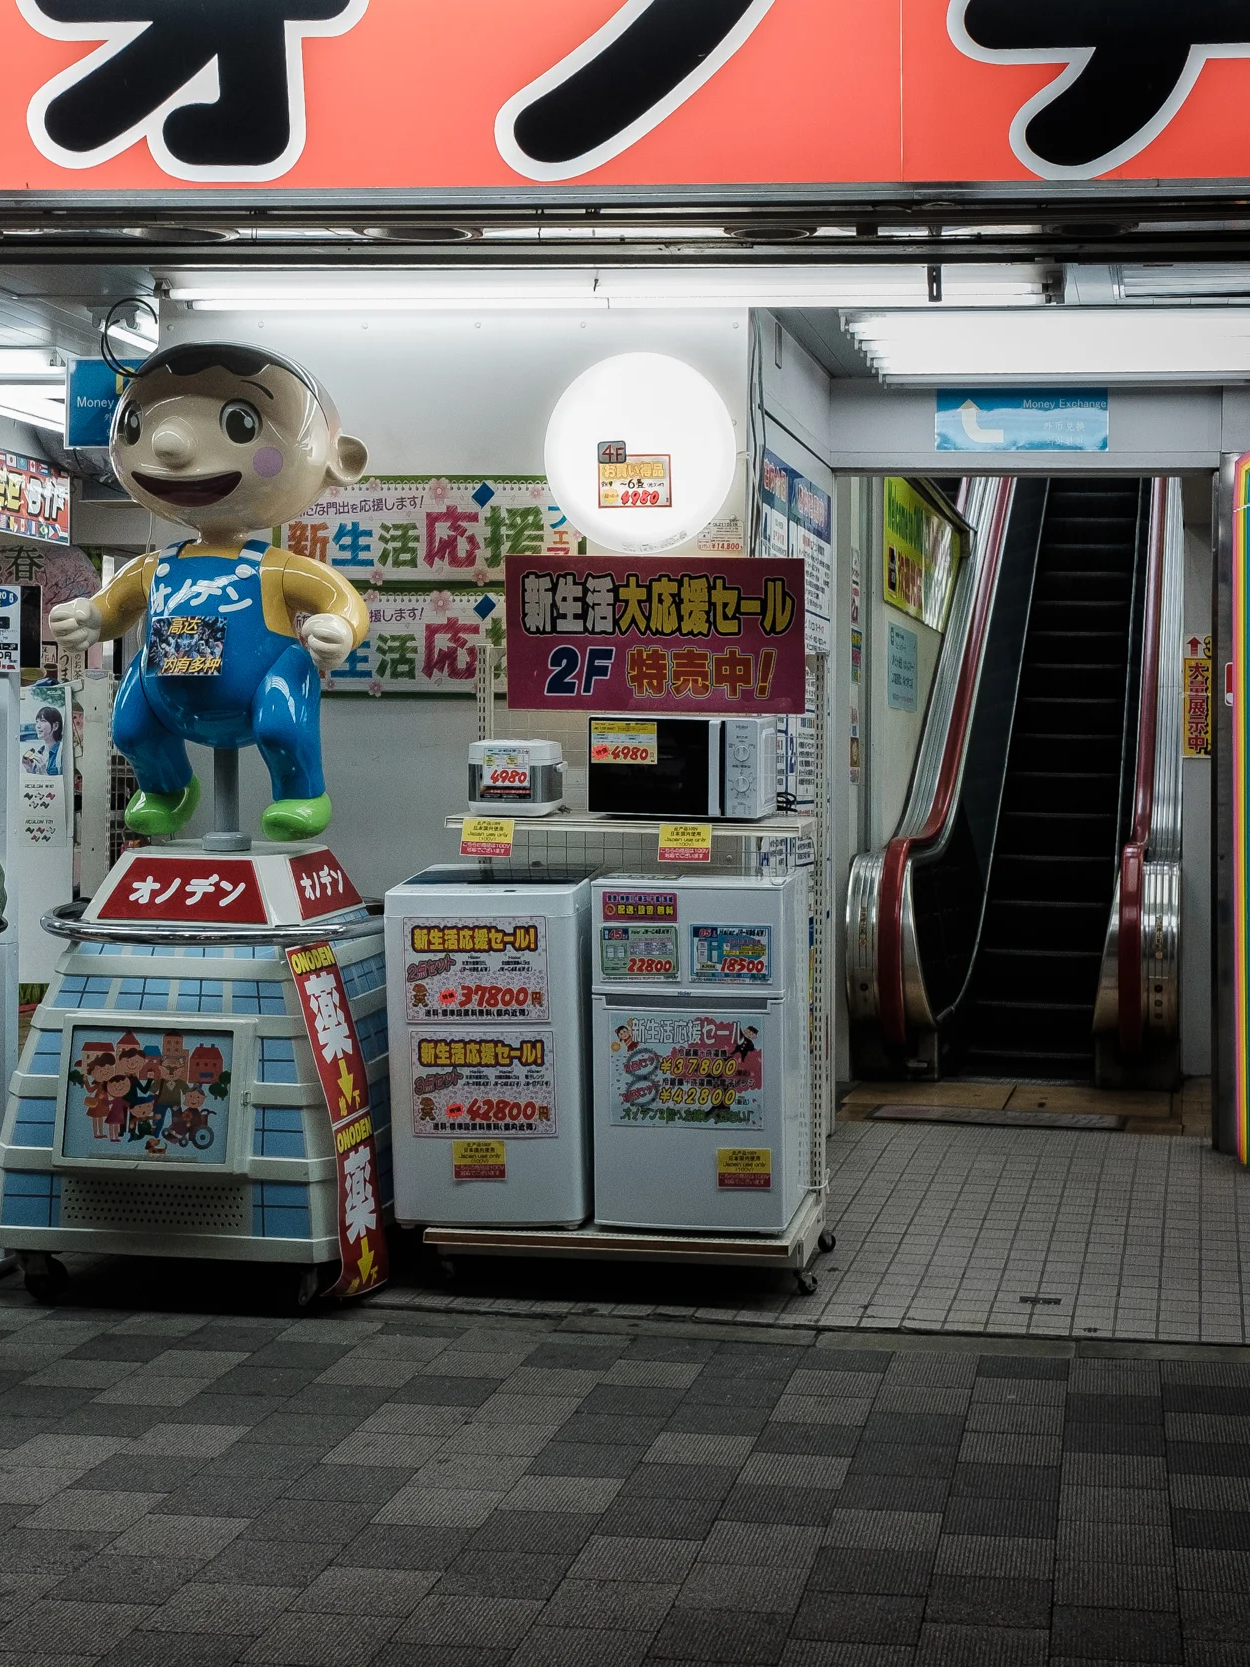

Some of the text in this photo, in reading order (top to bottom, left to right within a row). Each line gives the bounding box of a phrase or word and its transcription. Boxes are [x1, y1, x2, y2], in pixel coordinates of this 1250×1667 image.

[77, 396, 114, 409] Money
[1023, 399, 1107, 409] Money Exchange
[602, 444, 625, 463] 4F
[603, 462, 665, 478] お買い得品
[621, 490, 659, 505] 4980
[522, 571, 796, 637] 新生活大応援セール
[161, 656, 222, 674] 内有多种
[544, 645, 778, 700] 2F 特売中!
[1187, 662, 1208, 752] 大量展示中
[490, 769, 527, 784] 4980
[129, 873, 246, 907] オノデン
[299, 864, 344, 900] オノデン
[413, 927, 536, 950] 新生活応援セール!
[291, 946, 336, 976] ONODEN
[628, 958, 672, 973] 22800
[720, 957, 765, 973] 18500
[304, 971, 354, 1065] 薬
[632, 1018, 745, 1045] 新生活応援セール
[420, 1041, 543, 1065] 新生活応援セール!
[336, 1115, 372, 1153] ONODEN
[344, 1145, 377, 1245] 薬
